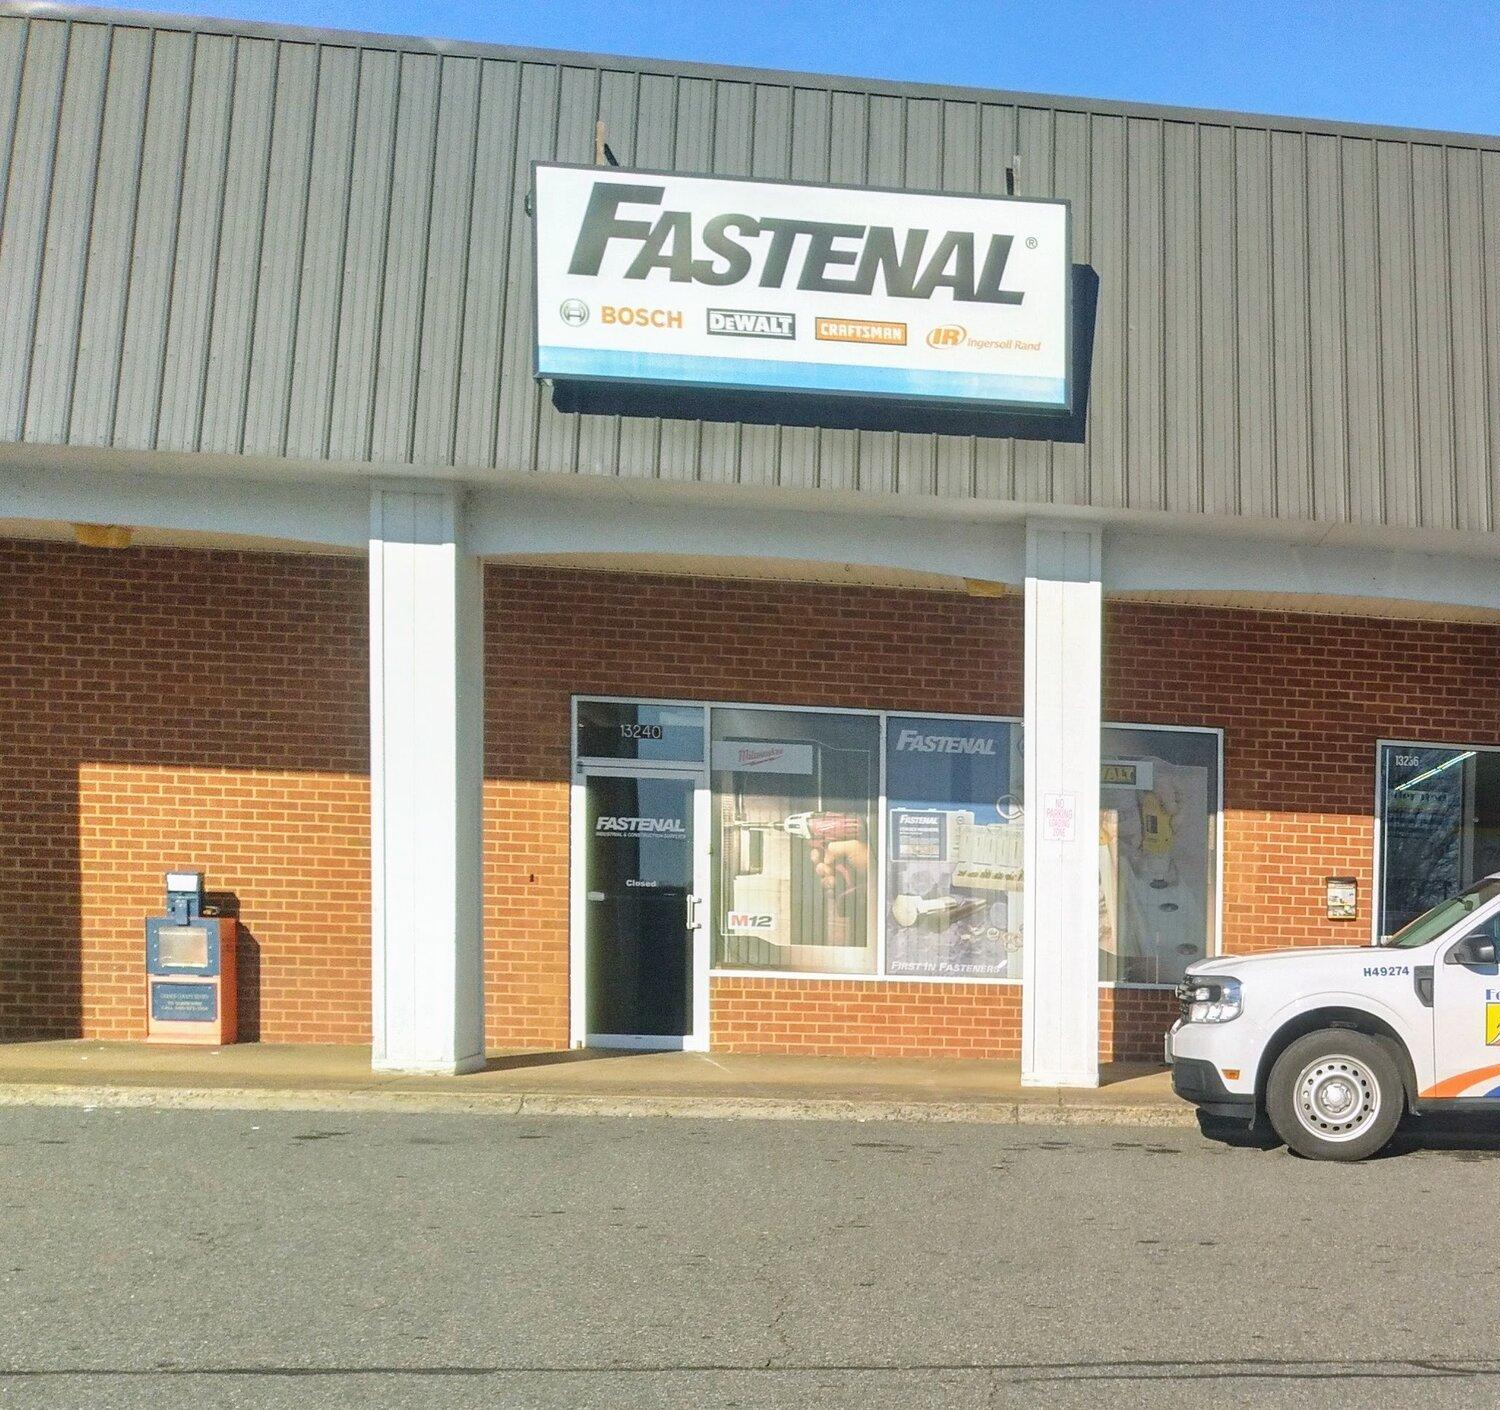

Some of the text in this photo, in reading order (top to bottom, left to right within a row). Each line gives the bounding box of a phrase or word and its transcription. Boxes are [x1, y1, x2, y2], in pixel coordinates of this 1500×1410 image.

[567, 181, 1025, 305] FASTENAL
[601, 305, 683, 329] BOSCH
[821, 322, 902, 340] CRAFTSMAN
[932, 328, 960, 346] IR
[967, 337, 1041, 352] Ingersoll Rand
[620, 723, 662, 739] 13240
[896, 730, 996, 755] FASTENAL
[596, 816, 686, 832] FASTENAL
[626, 879, 656, 887] Closed
[731, 915, 772, 927] M12
[939, 962, 1001, 973] FASTENERS
[1363, 966, 1410, 978] H49274
